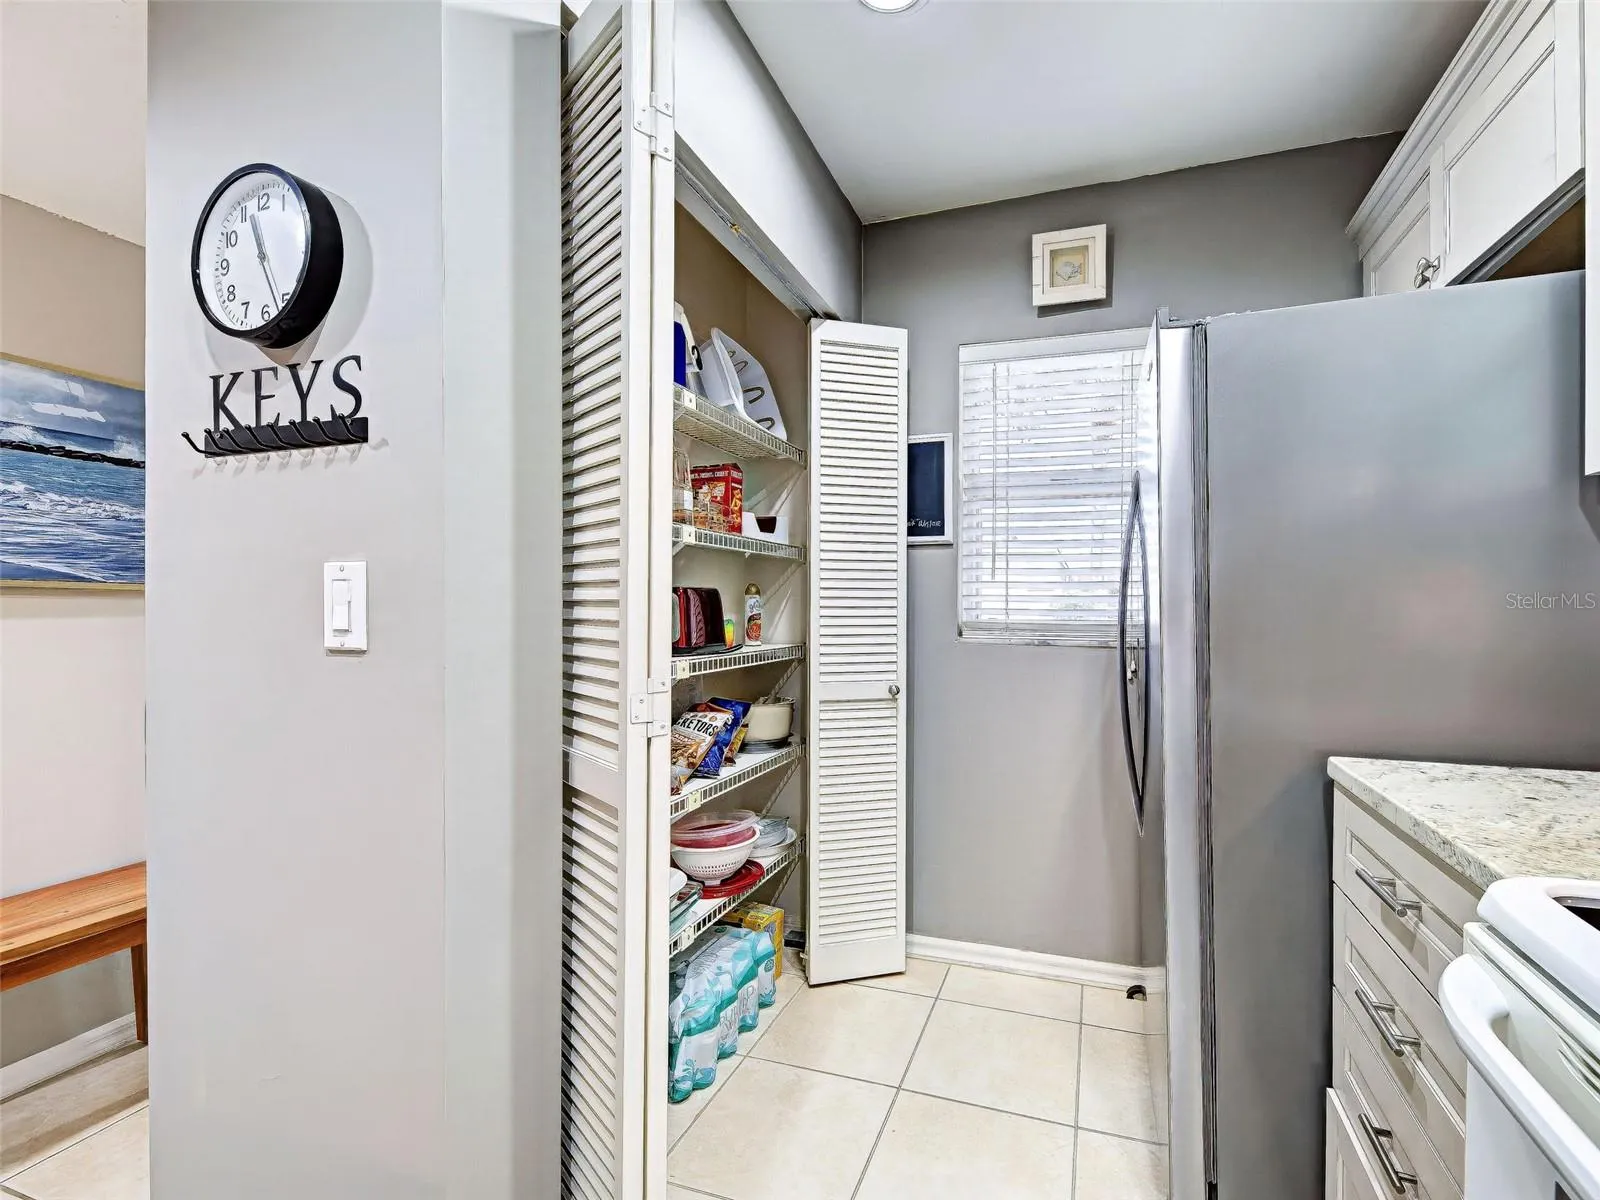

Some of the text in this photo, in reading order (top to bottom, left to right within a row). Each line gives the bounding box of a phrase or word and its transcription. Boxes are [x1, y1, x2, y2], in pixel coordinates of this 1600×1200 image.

[257, 192, 271, 212] 12
[240, 204, 248, 224] 11
[225, 230, 239, 249] 10
[220, 258, 230, 277] 9
[226, 284, 236, 303] 8
[281, 292, 291, 306] 5
[240, 301, 251, 320] 7
[260, 303, 271, 322] 6
[209, 355, 363, 432] KEYS
